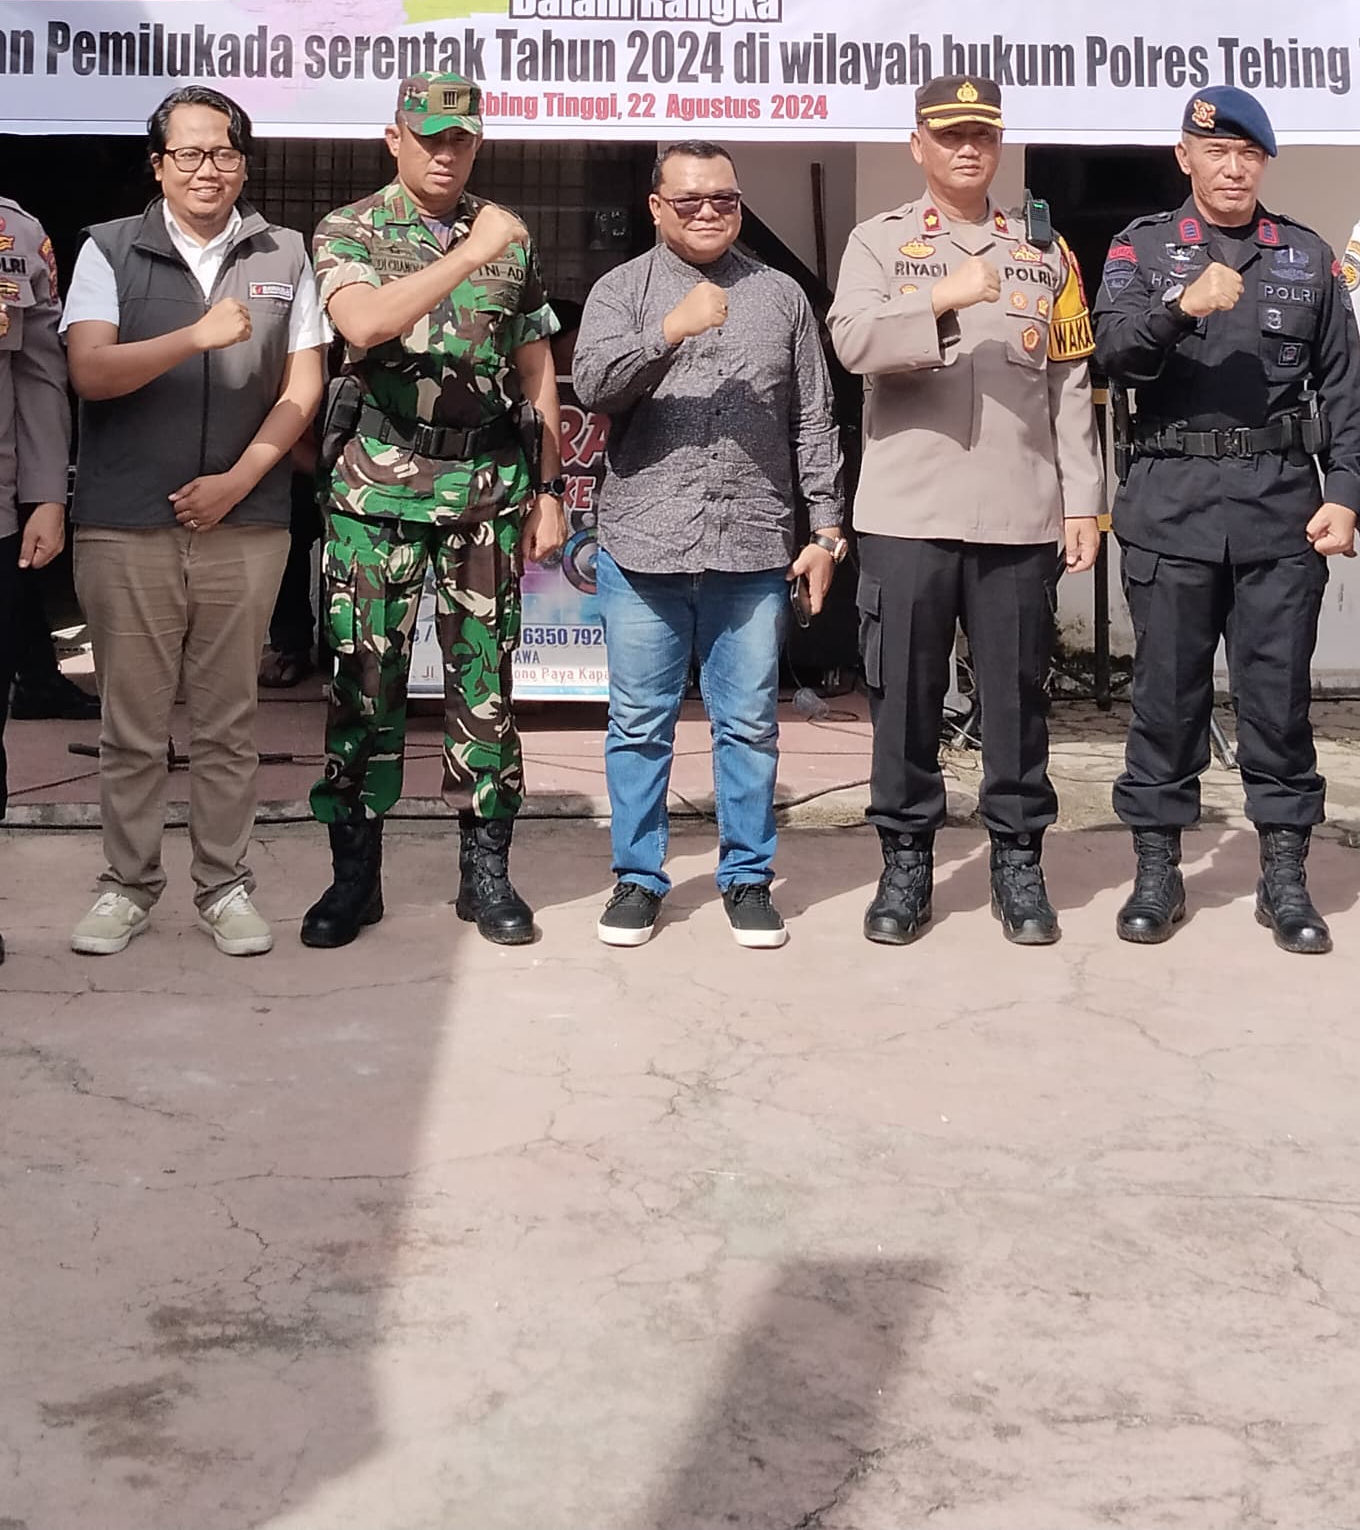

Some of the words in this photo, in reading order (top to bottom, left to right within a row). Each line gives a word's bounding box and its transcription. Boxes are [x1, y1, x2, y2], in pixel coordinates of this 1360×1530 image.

[46, 20, 293, 80] Pemilukada
[304, 28, 487, 81] serentak
[496, 28, 616, 82] Tahun
[626, 30, 725, 84] 2024
[734, 31, 770, 84] di
[779, 32, 932, 90] wilayah
[942, 34, 1076, 87] hukum
[1086, 35, 1209, 88] Polres
[1218, 37, 1351, 95] Tebing
[543, 93, 622, 121] Tinggi,
[627, 93, 656, 119] 22
[665, 94, 761, 121] Agustus
[770, 95, 829, 120] 2024
[894, 260, 949, 278] RIYADI
[1004, 266, 1052, 287] POLRI
[1263, 285, 1318, 303] POLRI
[522, 627, 568, 646] 6350
[541, 668, 575, 684] Paya
